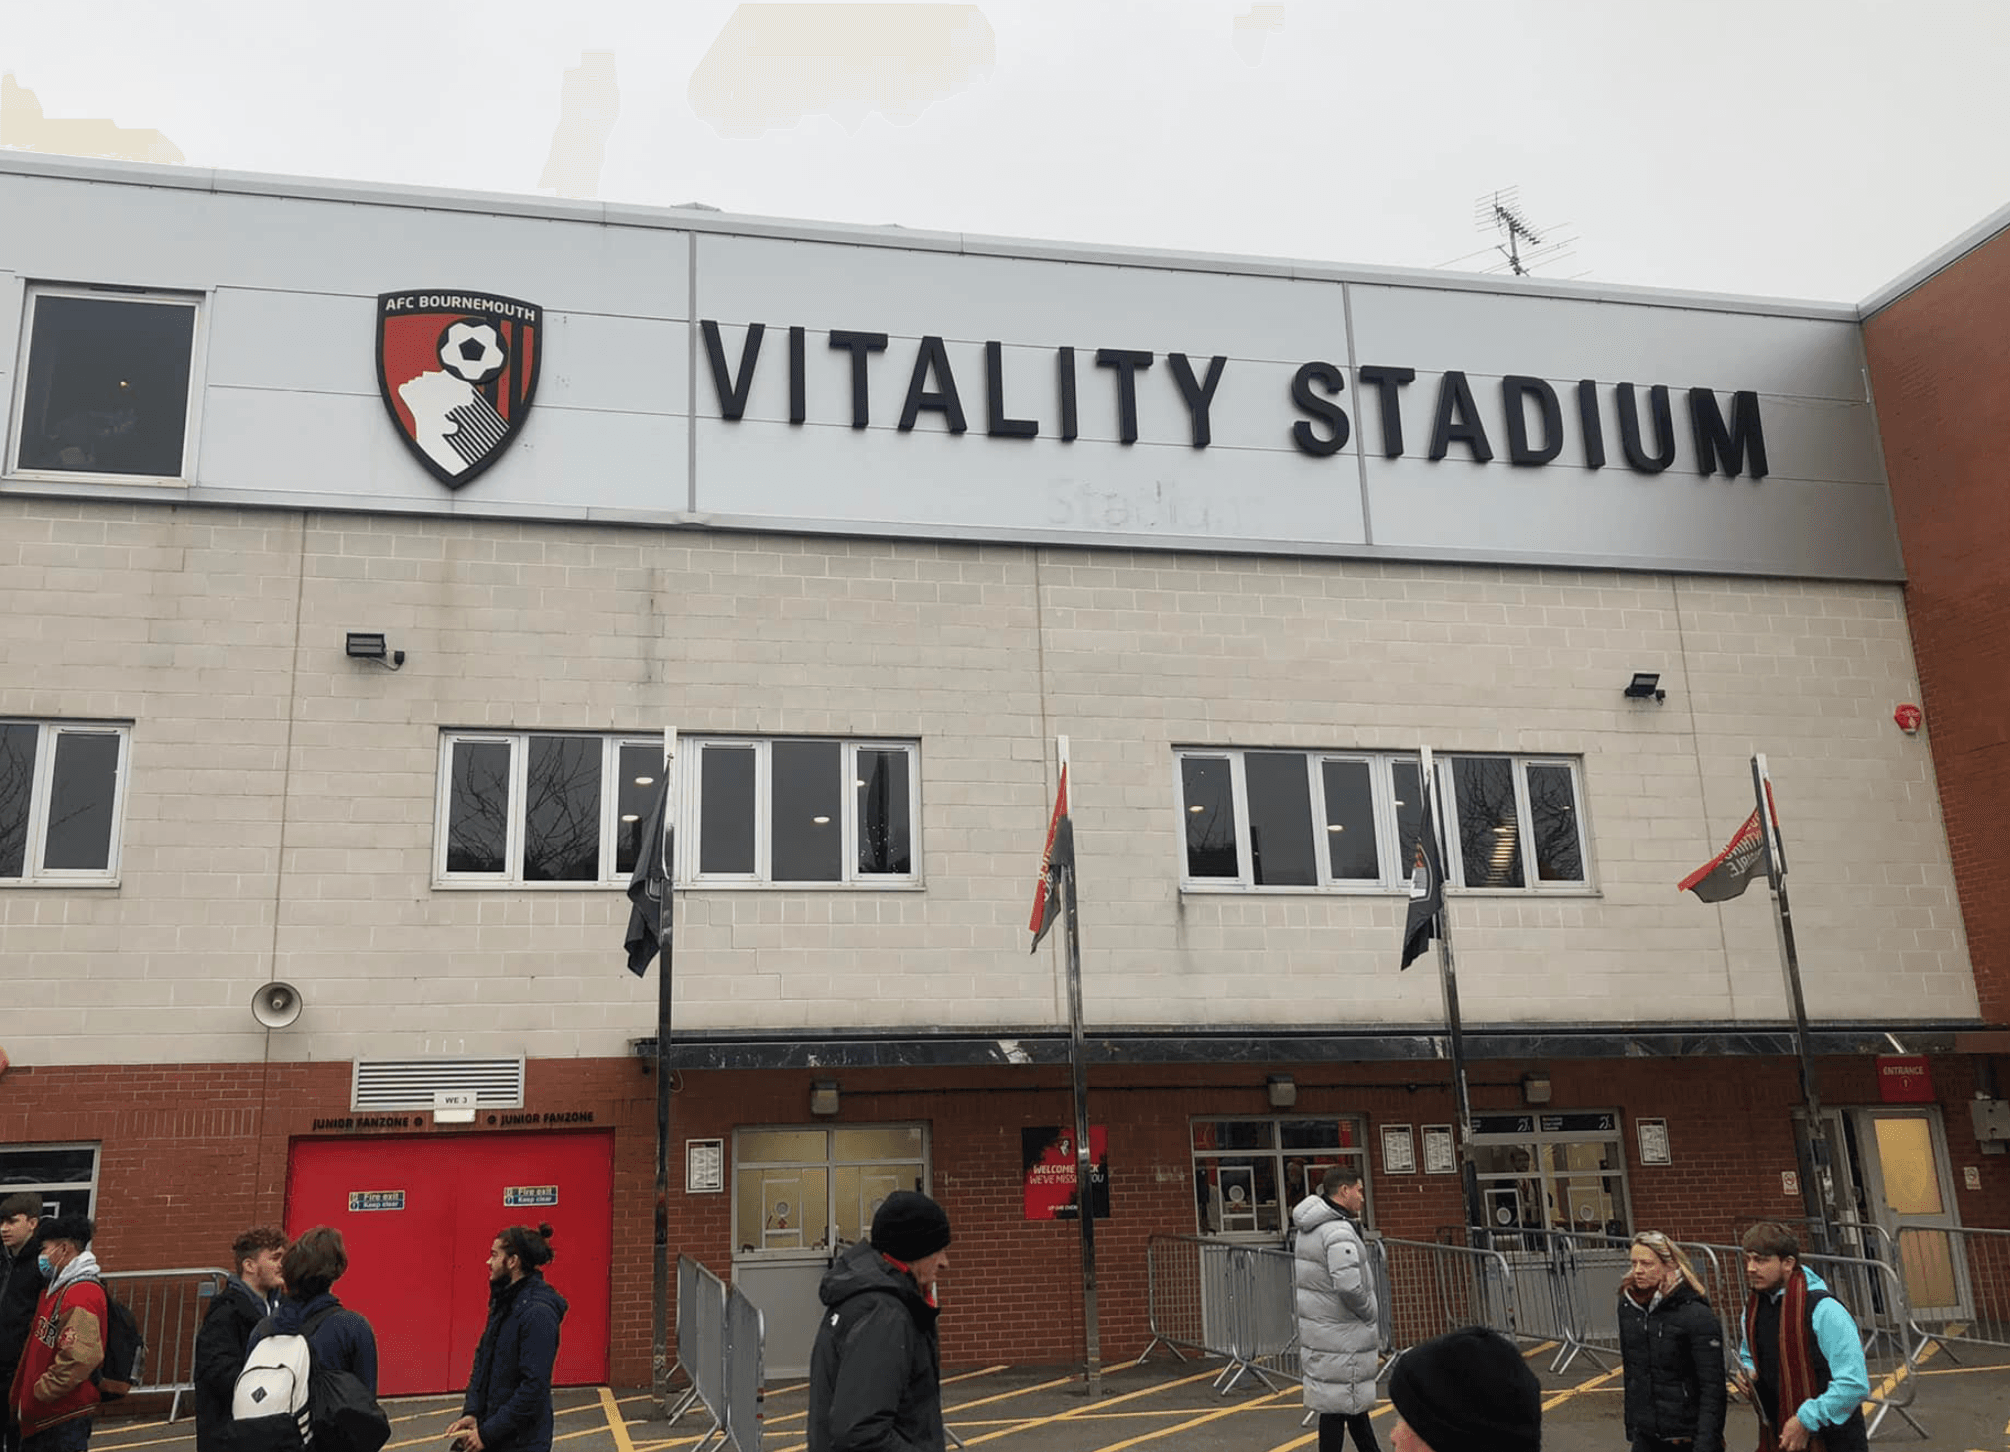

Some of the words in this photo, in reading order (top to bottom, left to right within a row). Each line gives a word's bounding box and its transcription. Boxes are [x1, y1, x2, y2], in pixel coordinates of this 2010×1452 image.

[385, 296, 414, 311] AFC
[419, 295, 536, 322] BOURNEMOUTH
[700, 319, 1228, 448] VITALITY
[1291, 360, 1770, 480] STADIUM
[1883, 1066, 1924, 1075] ENTRANCE
[312, 1117, 354, 1131] JUNIOR
[357, 1116, 409, 1128] FANZONE
[501, 1112, 541, 1126] JUNIOR
[543, 1111, 594, 1124] FANZONE
[1033, 1164, 1076, 1174] WELCOME
[364, 1192, 381, 1201] Fire
